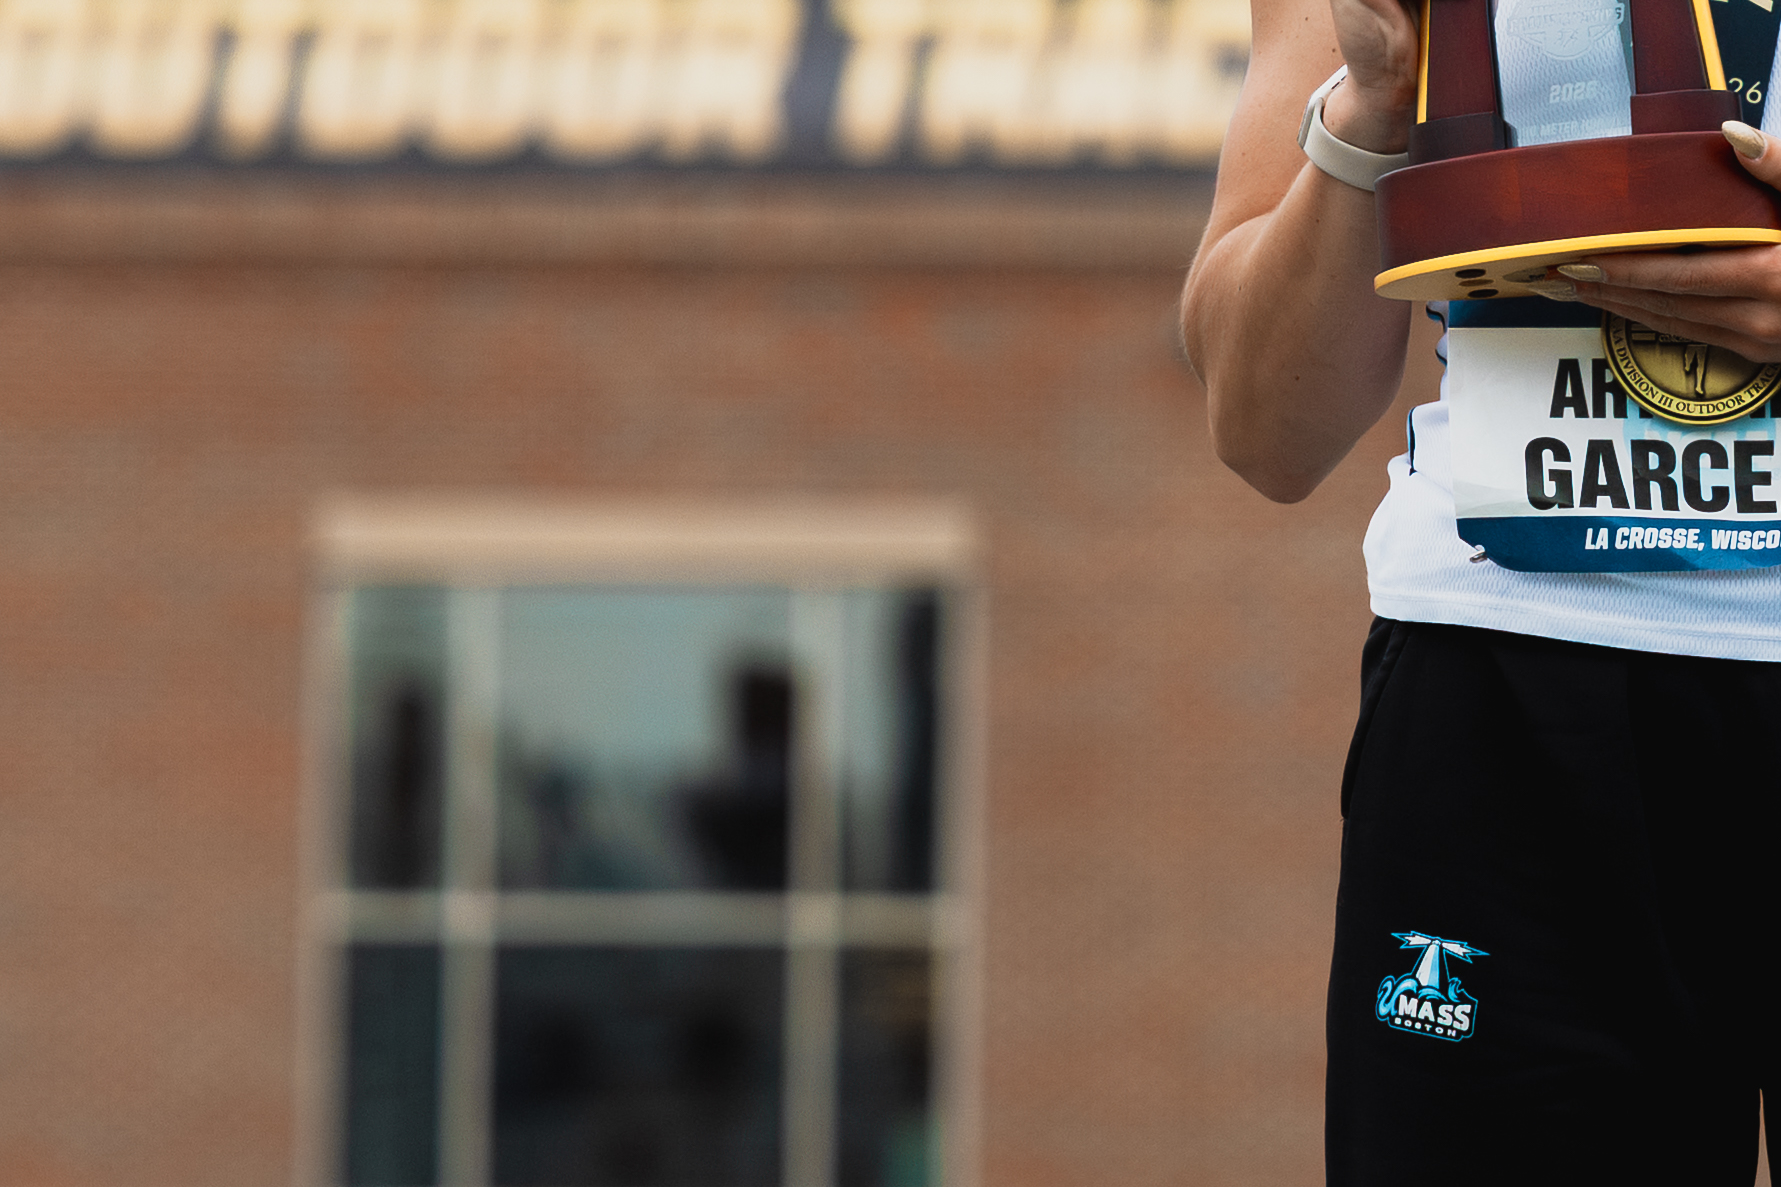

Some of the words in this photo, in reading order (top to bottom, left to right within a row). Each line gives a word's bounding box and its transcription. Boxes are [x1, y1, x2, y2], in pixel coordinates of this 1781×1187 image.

[1616, 347, 1657, 400] DIVISION
[1658, 394, 1674, 409] III
[1675, 395, 1746, 414] OUTDOOR
[1585, 527, 1610, 551] LA
[1615, 526, 1705, 552] CROSSE,
[1394, 1017, 1457, 1037] BOSTON
